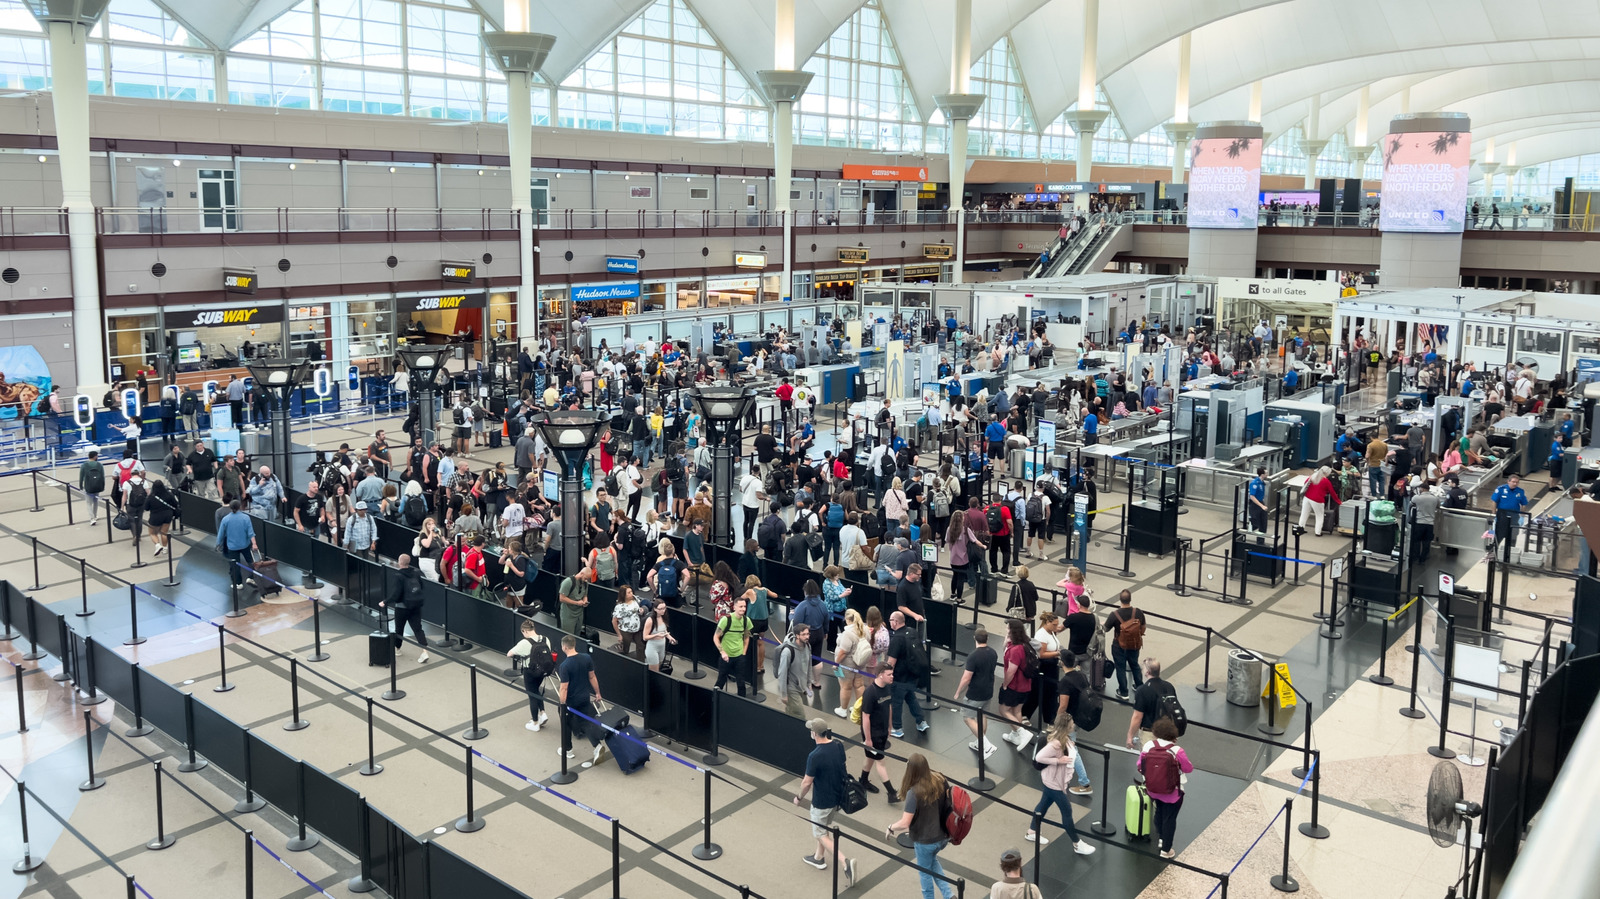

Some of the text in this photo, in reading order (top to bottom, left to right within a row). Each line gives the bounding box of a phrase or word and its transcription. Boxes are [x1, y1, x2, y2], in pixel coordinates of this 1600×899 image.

[1388, 164, 1451, 172] WHEN YOUR
[1214, 175, 1247, 183] NEEDS
[1417, 173, 1454, 182] NEEDS
[1385, 183, 1454, 191] ANOTHER DAY
[442, 268, 471, 277] SUBWAY
[225, 276, 251, 288] SUBWAY
[576, 287, 634, 299] Hudson News
[416, 296, 466, 310] SUBWAY
[192, 308, 258, 325] SUBWAY
